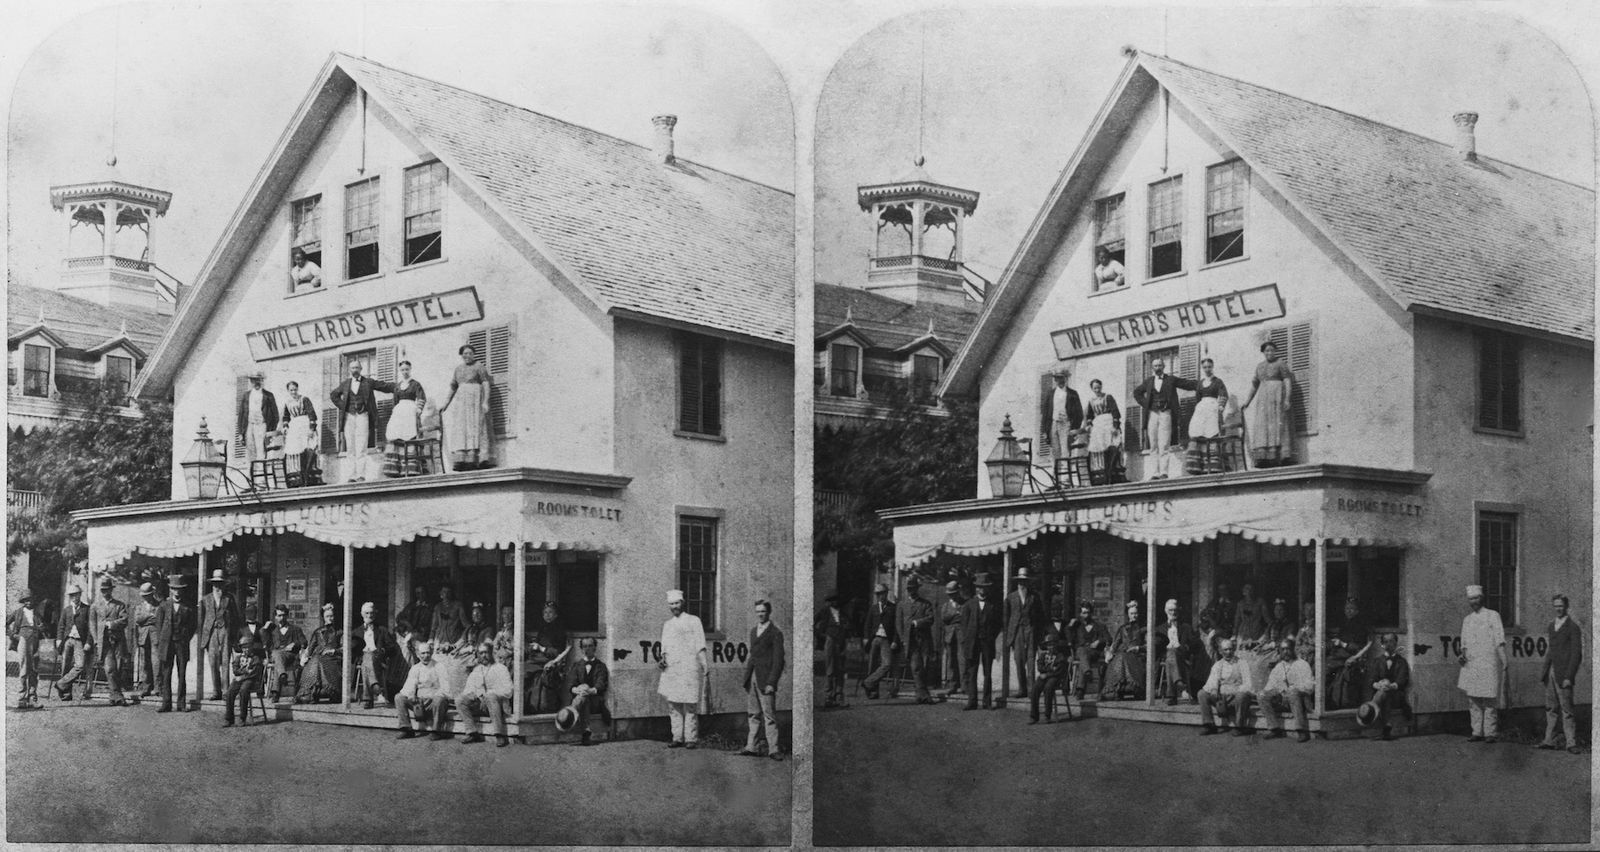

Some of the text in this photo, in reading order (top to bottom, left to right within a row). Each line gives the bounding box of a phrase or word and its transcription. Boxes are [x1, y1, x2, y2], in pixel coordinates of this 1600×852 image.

[1177, 294, 1263, 328] HOTEL.
[262, 297, 461, 352] WILLARD'S HOTEL.
[300, 503, 370, 526] HOURS
[537, 501, 578, 517] ROOMS
[599, 507, 621, 522] LET
[1103, 501, 1173, 523] HOURS
[639, 640, 749, 664] TO ROO
[1440, 635, 1548, 658] TO ROO
